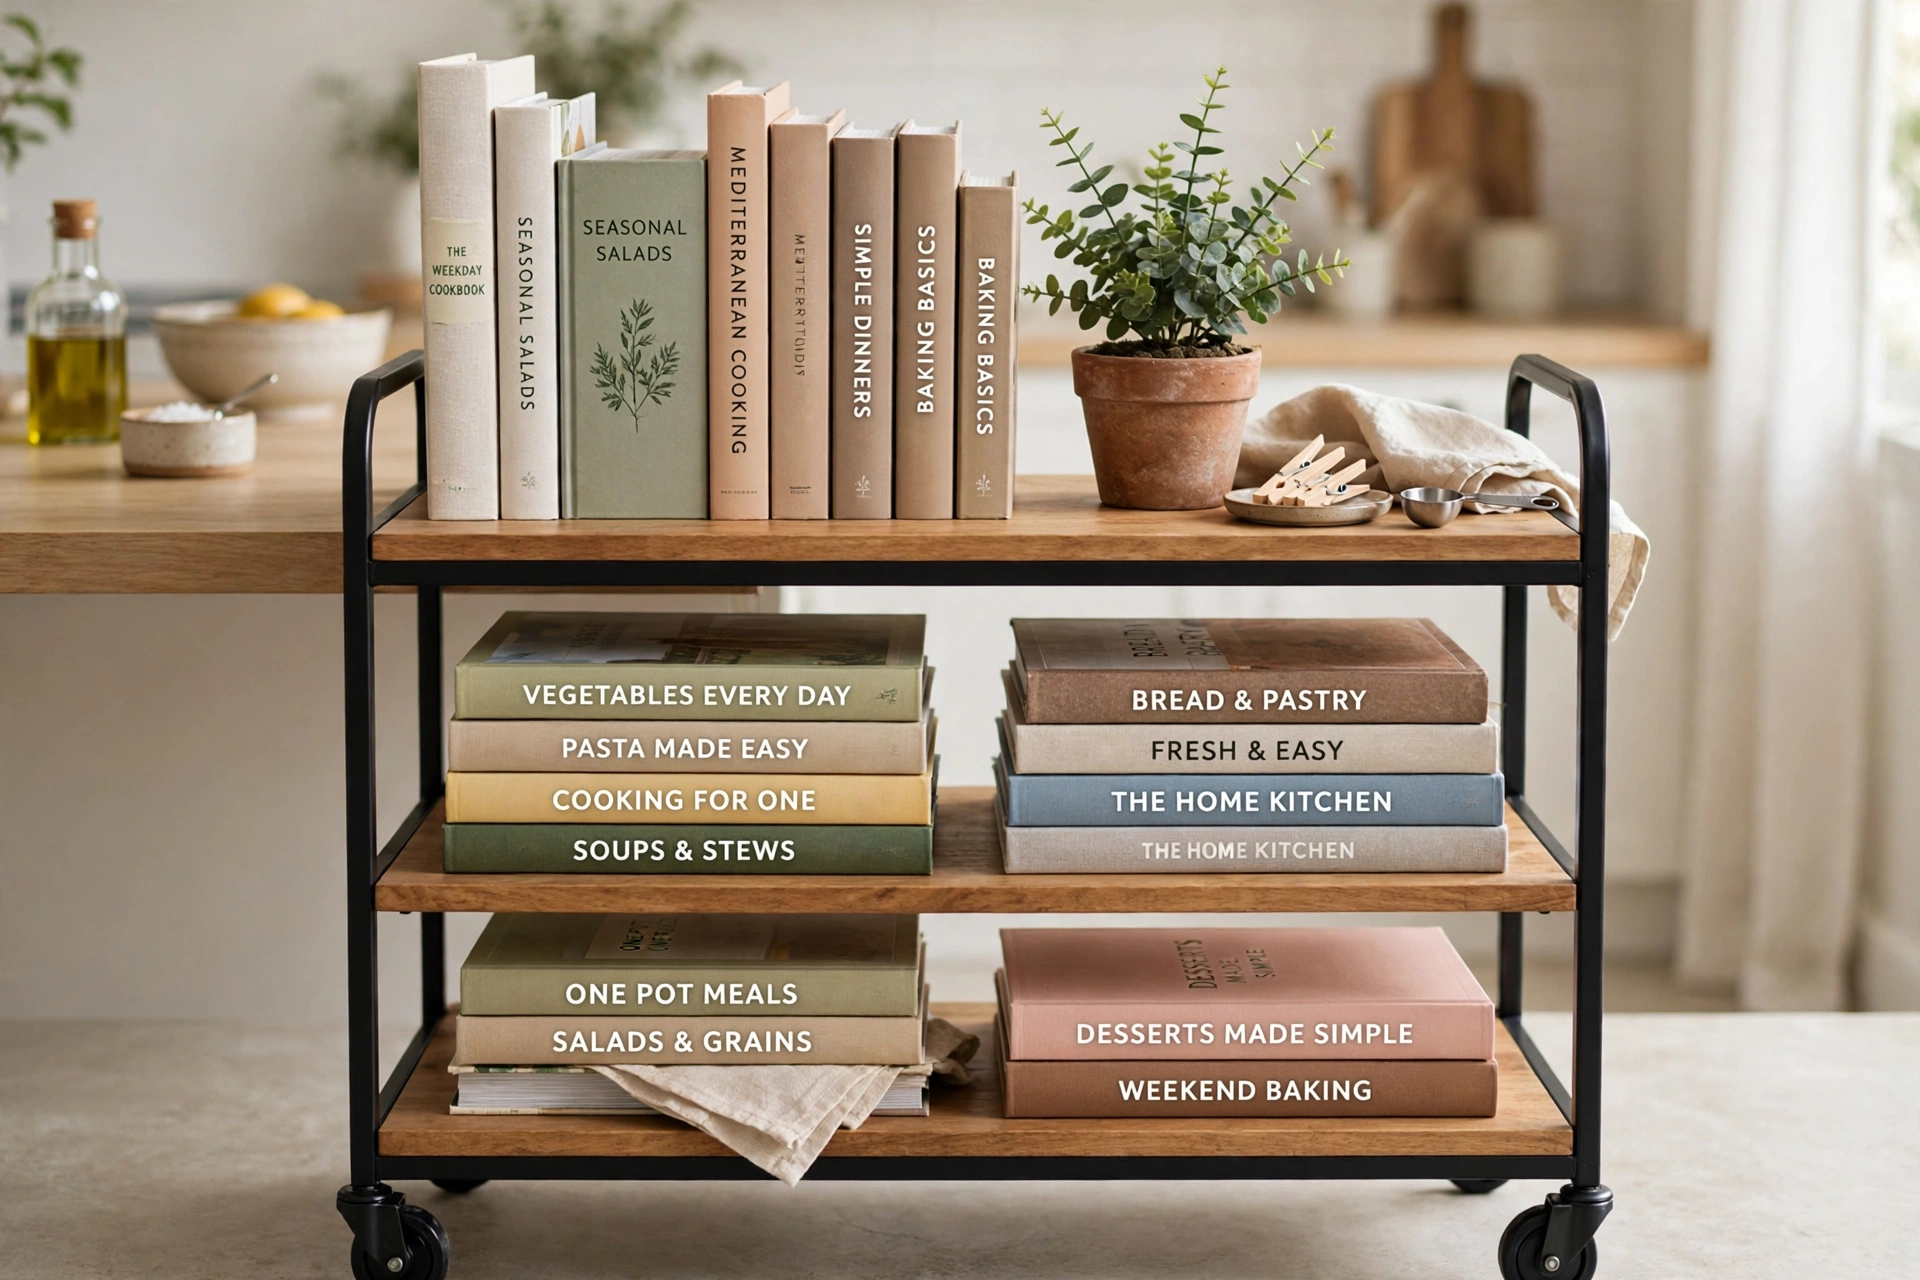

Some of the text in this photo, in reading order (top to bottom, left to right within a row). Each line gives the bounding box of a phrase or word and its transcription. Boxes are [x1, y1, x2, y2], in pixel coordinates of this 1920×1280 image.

[584, 220, 686, 235] SEASONAL
[447, 247, 466, 257] THE
[597, 246, 671, 261] SALADS
[432, 265, 481, 276] WEEKDAY
[429, 284, 484, 295] COOKBOOK
[731, 147, 746, 453] MEDITERRANEAN COOKING
[518, 218, 534, 410] SEASONAL SALADS
[854, 224, 871, 417] SIMPLE DINNERS
[917, 226, 935, 412] BAKING BASICS
[977, 259, 995, 434] BAKING BASICS
[523, 685, 851, 705] VEGETABLES EVERY DAY
[1133, 690, 1366, 710] BREAD & PASTRY
[563, 738, 808, 758] PASTA MADE EASY
[1152, 741, 1343, 760] FRESH & EASY
[553, 790, 815, 810] COOKING FOR ONE
[1111, 791, 1391, 812] THE HOME KITCHEN
[574, 840, 794, 860] SOUPS & STEWS
[1142, 842, 1354, 859] THE HOME KITCHEN
[566, 984, 797, 1004] ONE POT MEALS
[553, 1031, 811, 1052] SALADS & GRAINS
[1078, 1024, 1412, 1044] DESSERTS MADE SIMPLE
[1119, 1080, 1371, 1100] WEEKEND BAKING
